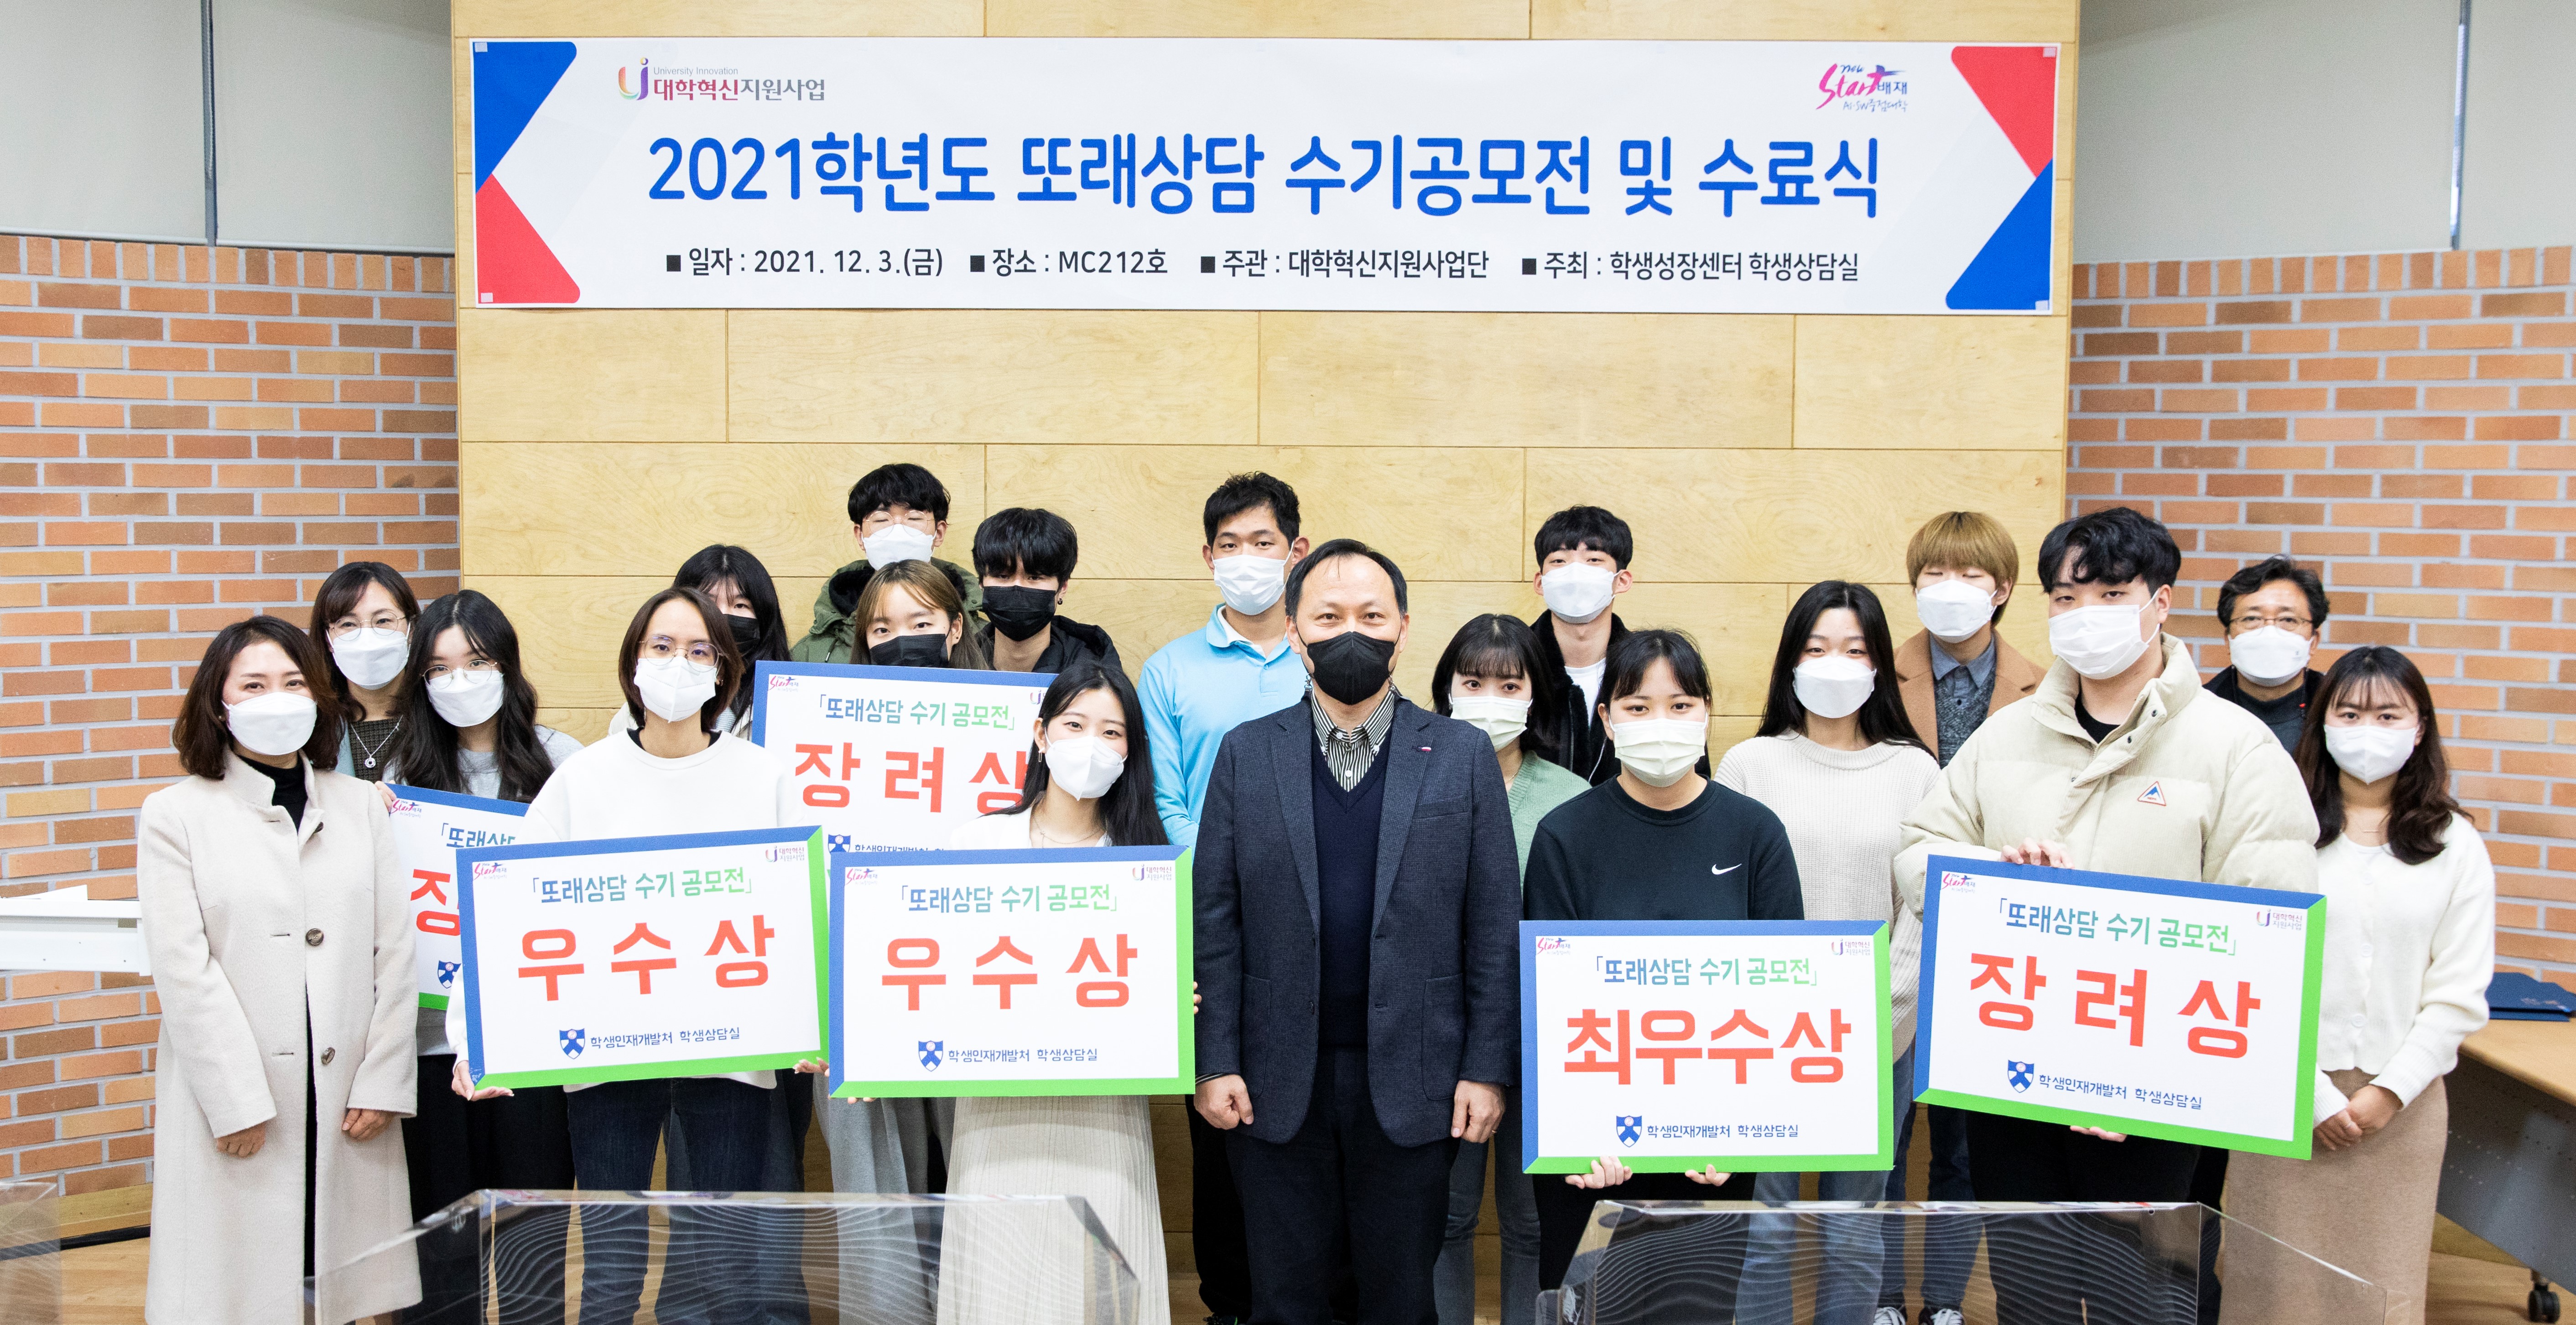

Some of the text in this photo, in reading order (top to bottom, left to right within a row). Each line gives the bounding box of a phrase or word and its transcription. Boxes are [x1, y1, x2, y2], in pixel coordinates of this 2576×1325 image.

[654, 67, 738, 75] University Innovation
[654, 79, 825, 100] 대학혁신지원사업
[649, 131, 1878, 218] 2021학년도 또래상담 수기공모전 및 수료식
[689, 248, 733, 276] 일자
[755, 250, 823, 273] 2021.
[834, 250, 869, 273] 12.
[992, 248, 1036, 276] 장소
[1060, 248, 1168, 274] MC212호
[1223, 249, 1268, 277] 주관
[1289, 249, 1489, 279] 대학혁신지원사업단
[1544, 251, 1587, 279] 주최
[1610, 251, 1741, 281] 학생성장센터
[1749, 252, 1858, 282] 학생상담실
[820, 694, 1014, 730] 「또래상담 수기 공모전」
[533, 867, 752, 904] 「또래상담 수기 공모전」
[902, 884, 1117, 913] 「또래상담 수기 공모전」
[2000, 898, 2236, 956] 「또래상담 수기 공모전」
[1597, 956, 1817, 986] 「또래상담 수기 공모전」
[591, 1027, 740, 1049] 학생인재개발처 학생상담실
[1564, 1009, 1852, 1085] 최우수상
[948, 1049, 1097, 1063] 학생인재개발처 학생상담실
[2039, 1075, 2202, 1110] 학생인재개발처 학생상담실
[1647, 1125, 1798, 1138] 학생인재개발처 학생상담실
